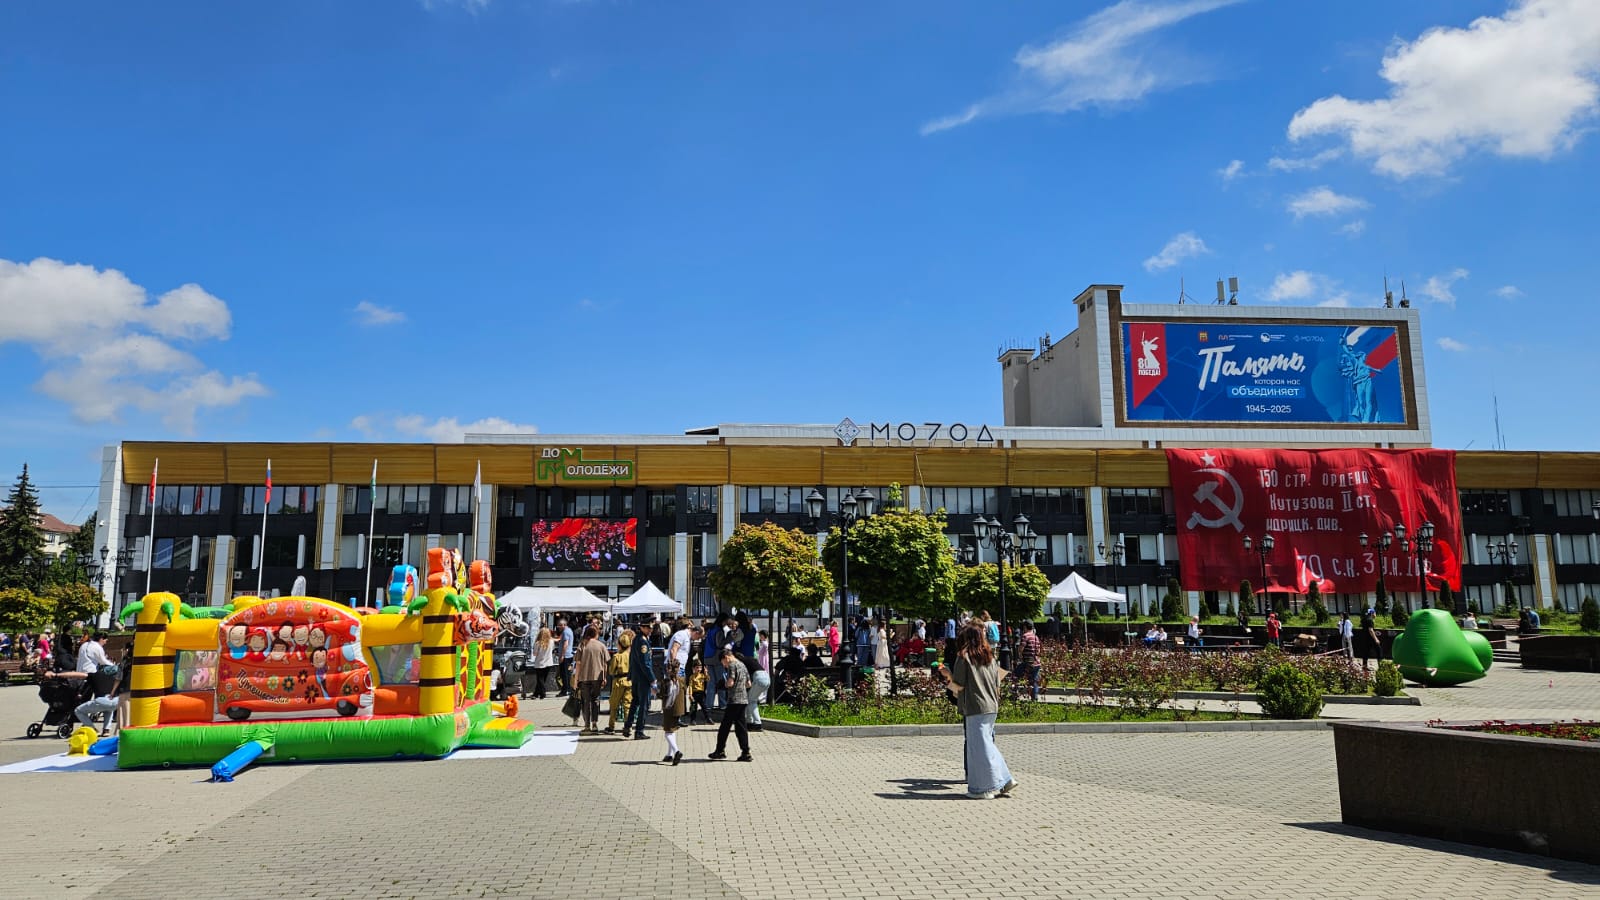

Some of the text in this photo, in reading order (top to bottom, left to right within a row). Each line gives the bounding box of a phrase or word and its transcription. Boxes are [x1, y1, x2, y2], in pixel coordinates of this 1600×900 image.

[1198, 344, 1306, 391] Память,
[1231, 384, 1300, 397] объединяет
[1259, 469, 1369, 488] 150 СТР. ОРДЕНА
[1340, 490, 1354, 512] II
[1266, 517, 1343, 533] ИДРИЦК. ДИВ.
[1362, 552, 1375, 574] 3
